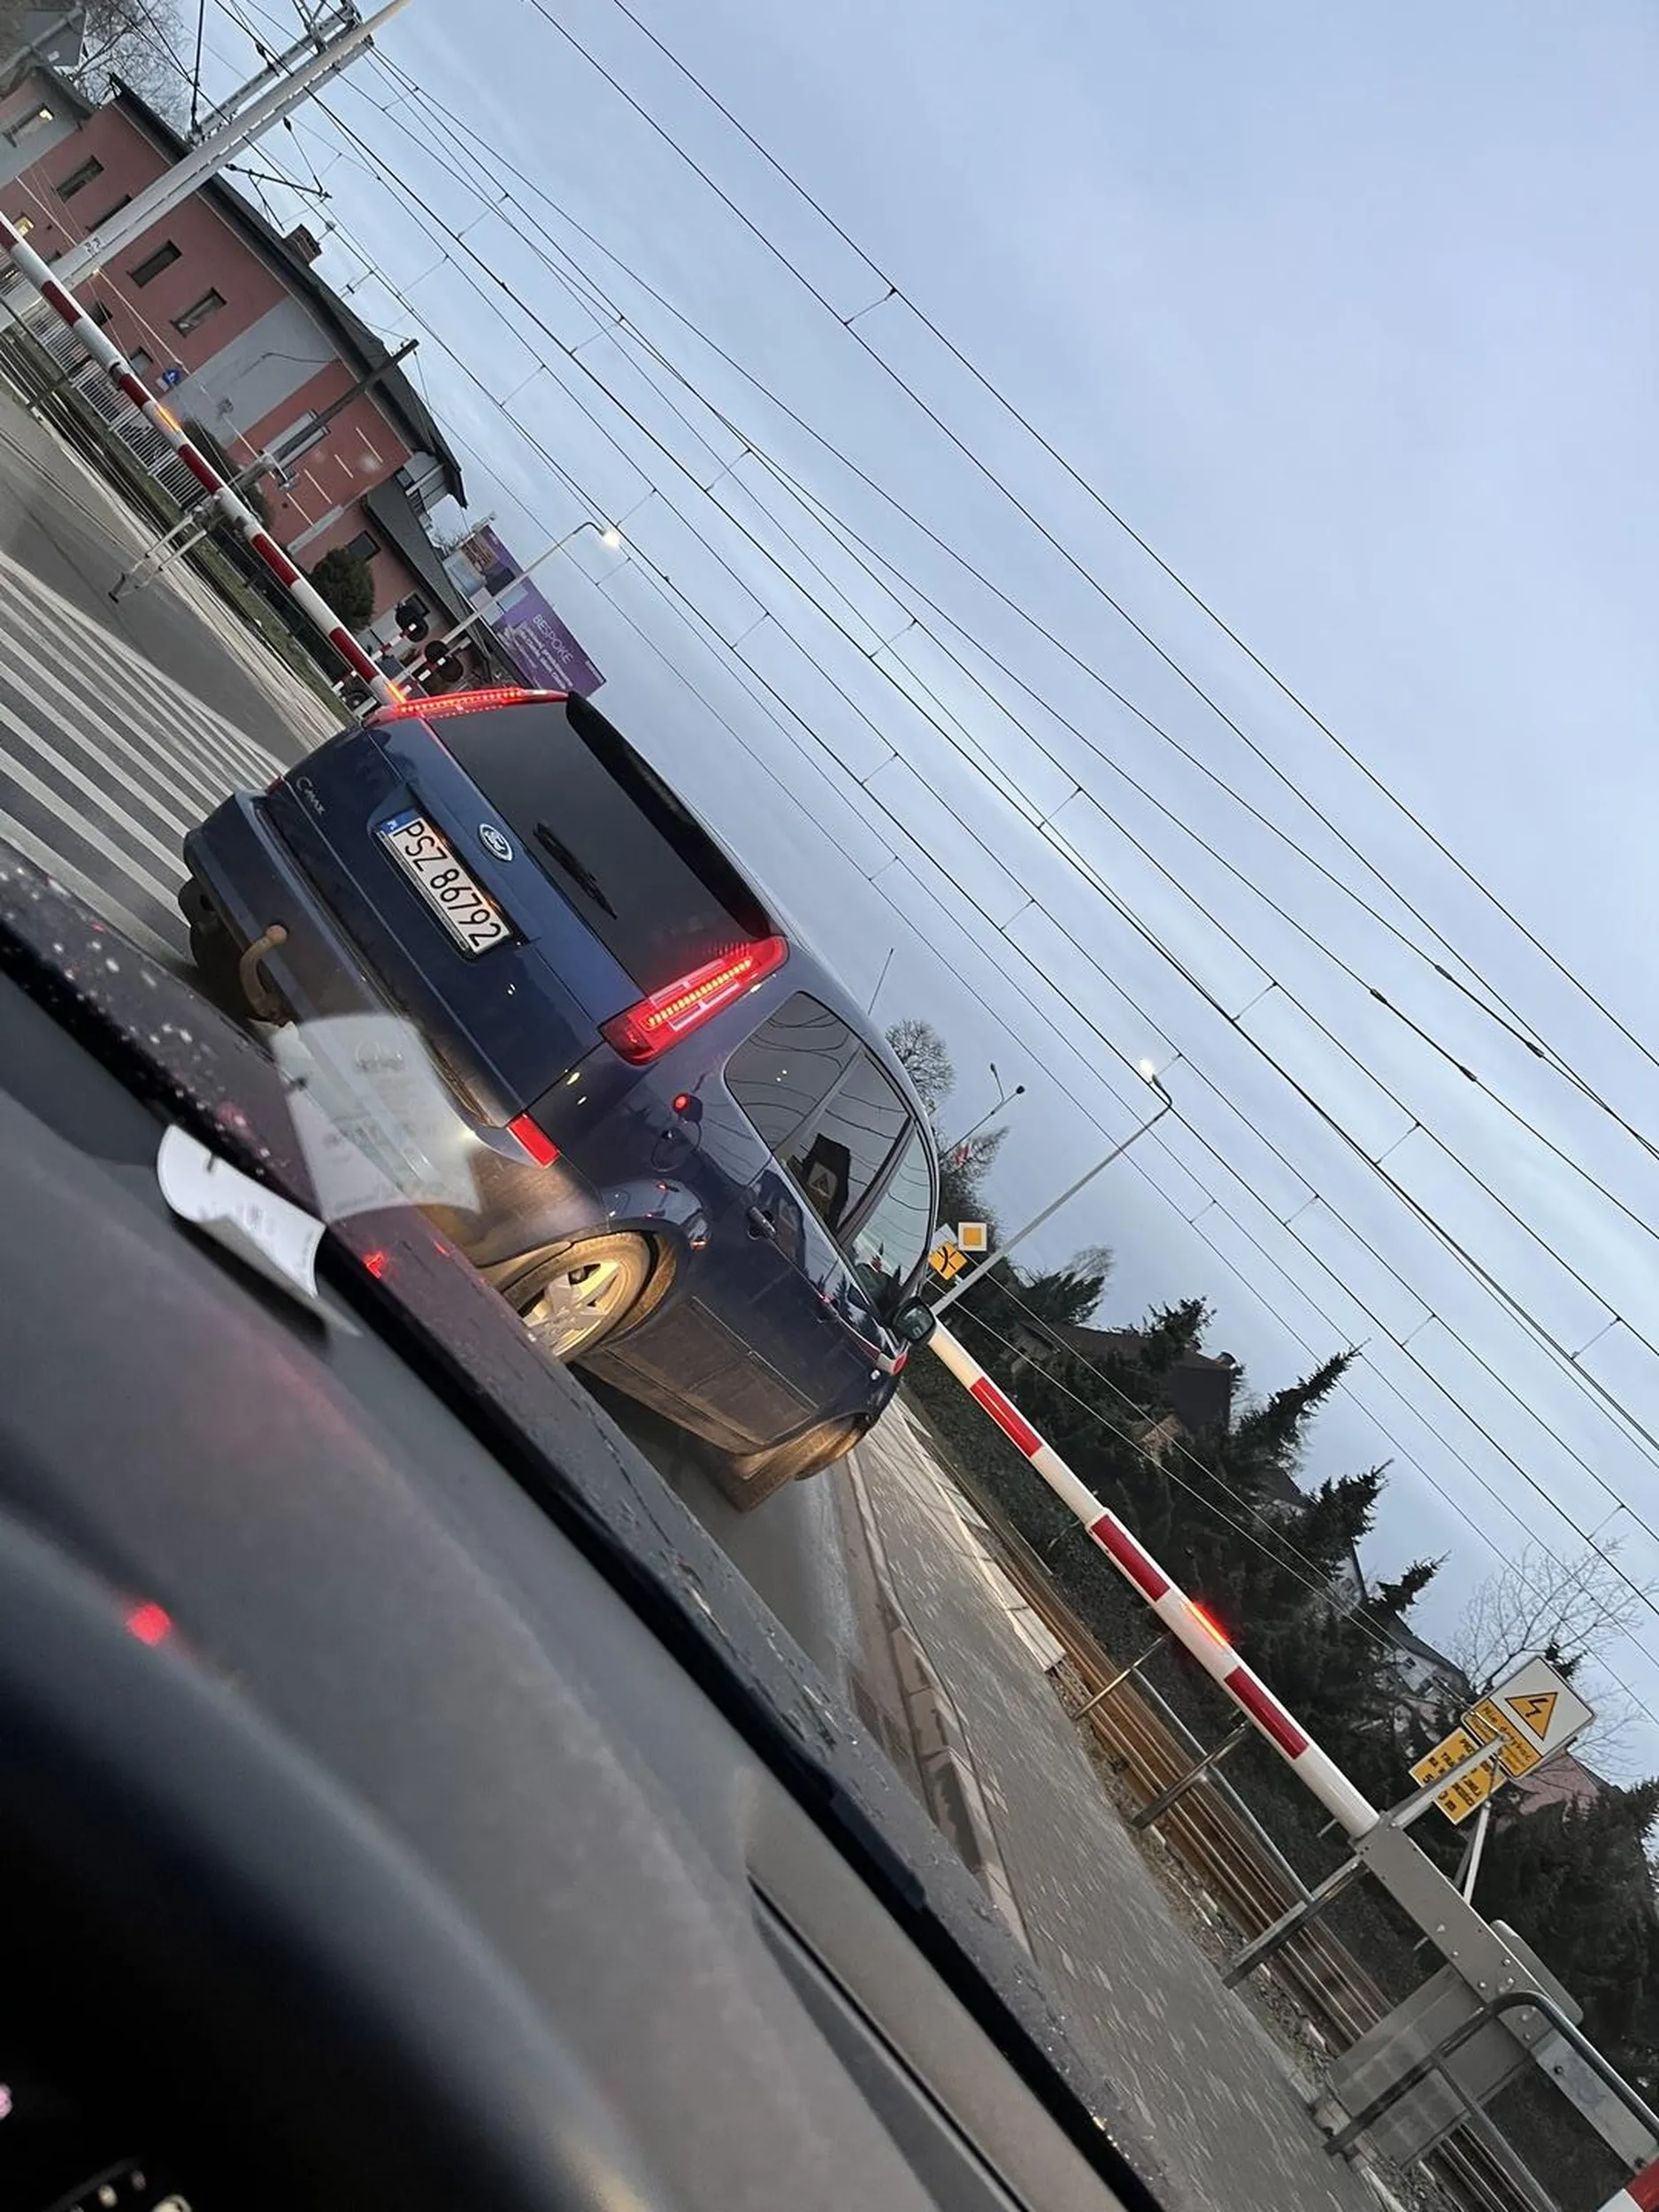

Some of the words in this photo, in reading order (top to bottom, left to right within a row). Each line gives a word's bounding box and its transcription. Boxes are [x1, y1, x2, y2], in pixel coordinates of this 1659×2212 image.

[533, 613, 574, 664] BESPOKE
[393, 820, 448, 872] PSZ
[430, 868, 502, 947] 86792
